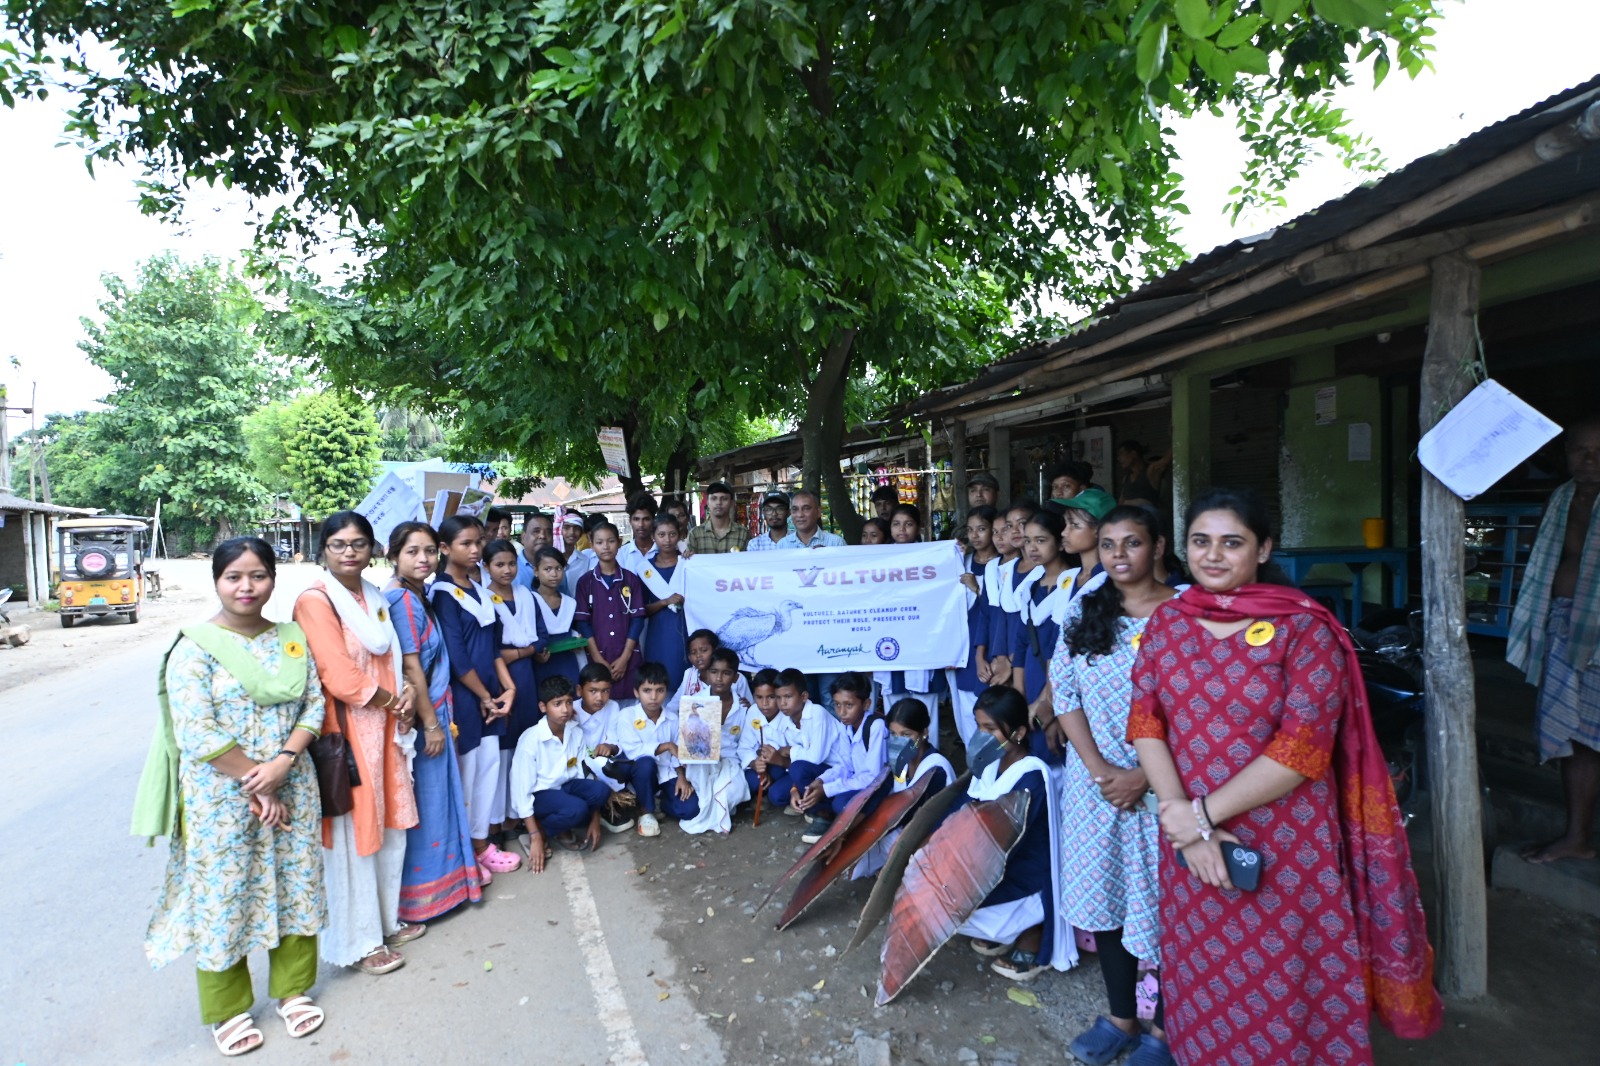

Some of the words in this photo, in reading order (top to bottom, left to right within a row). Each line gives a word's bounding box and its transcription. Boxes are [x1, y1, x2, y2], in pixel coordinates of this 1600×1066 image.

[715, 575, 774, 593] SAVE
[792, 565, 937, 588] VULTURES
[817, 643, 871, 658] Aaranyak
